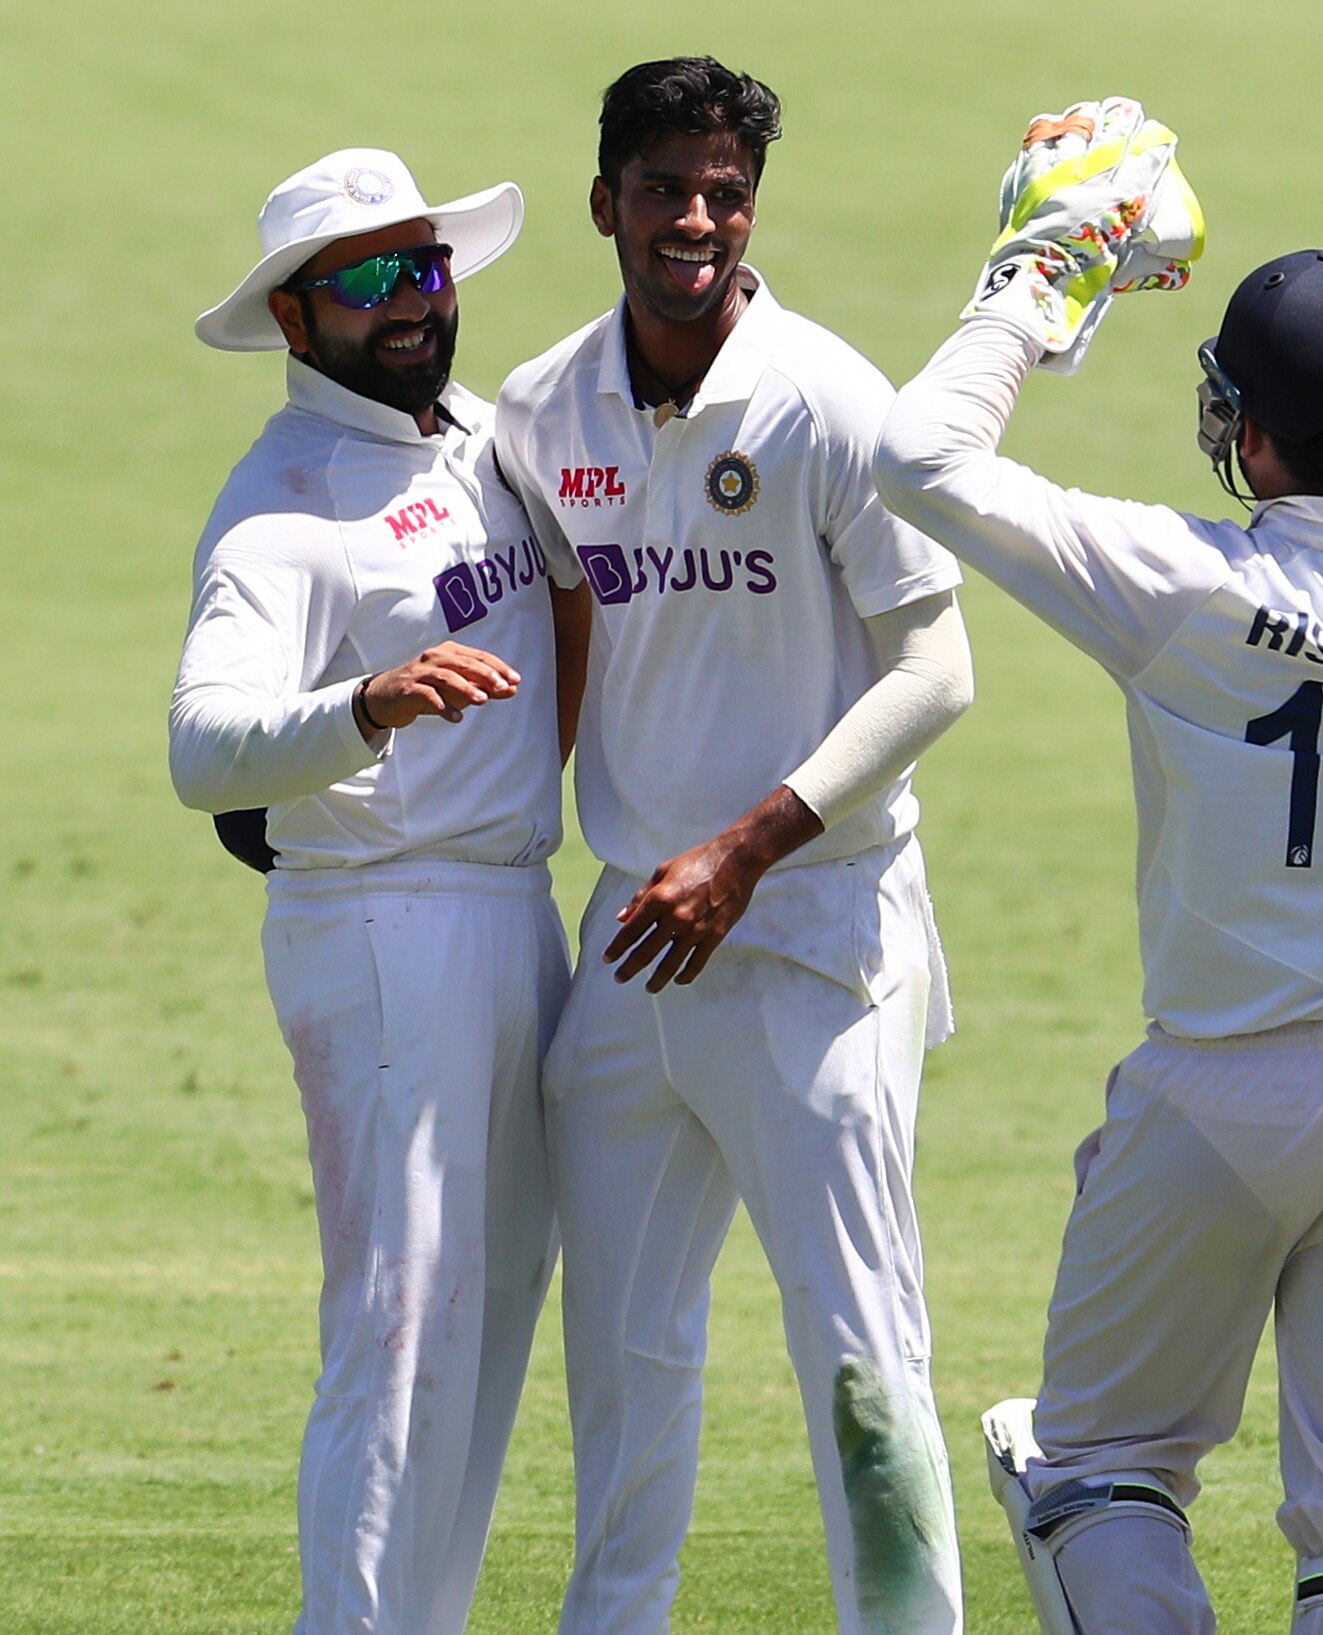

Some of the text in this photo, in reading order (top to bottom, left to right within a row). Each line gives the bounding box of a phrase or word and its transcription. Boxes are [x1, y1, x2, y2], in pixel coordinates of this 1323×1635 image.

[558, 466, 625, 498] MPL
[560, 496, 625, 508] SPORTS
[384, 497, 450, 541] MPL
[400, 517, 456, 549] SPORTS
